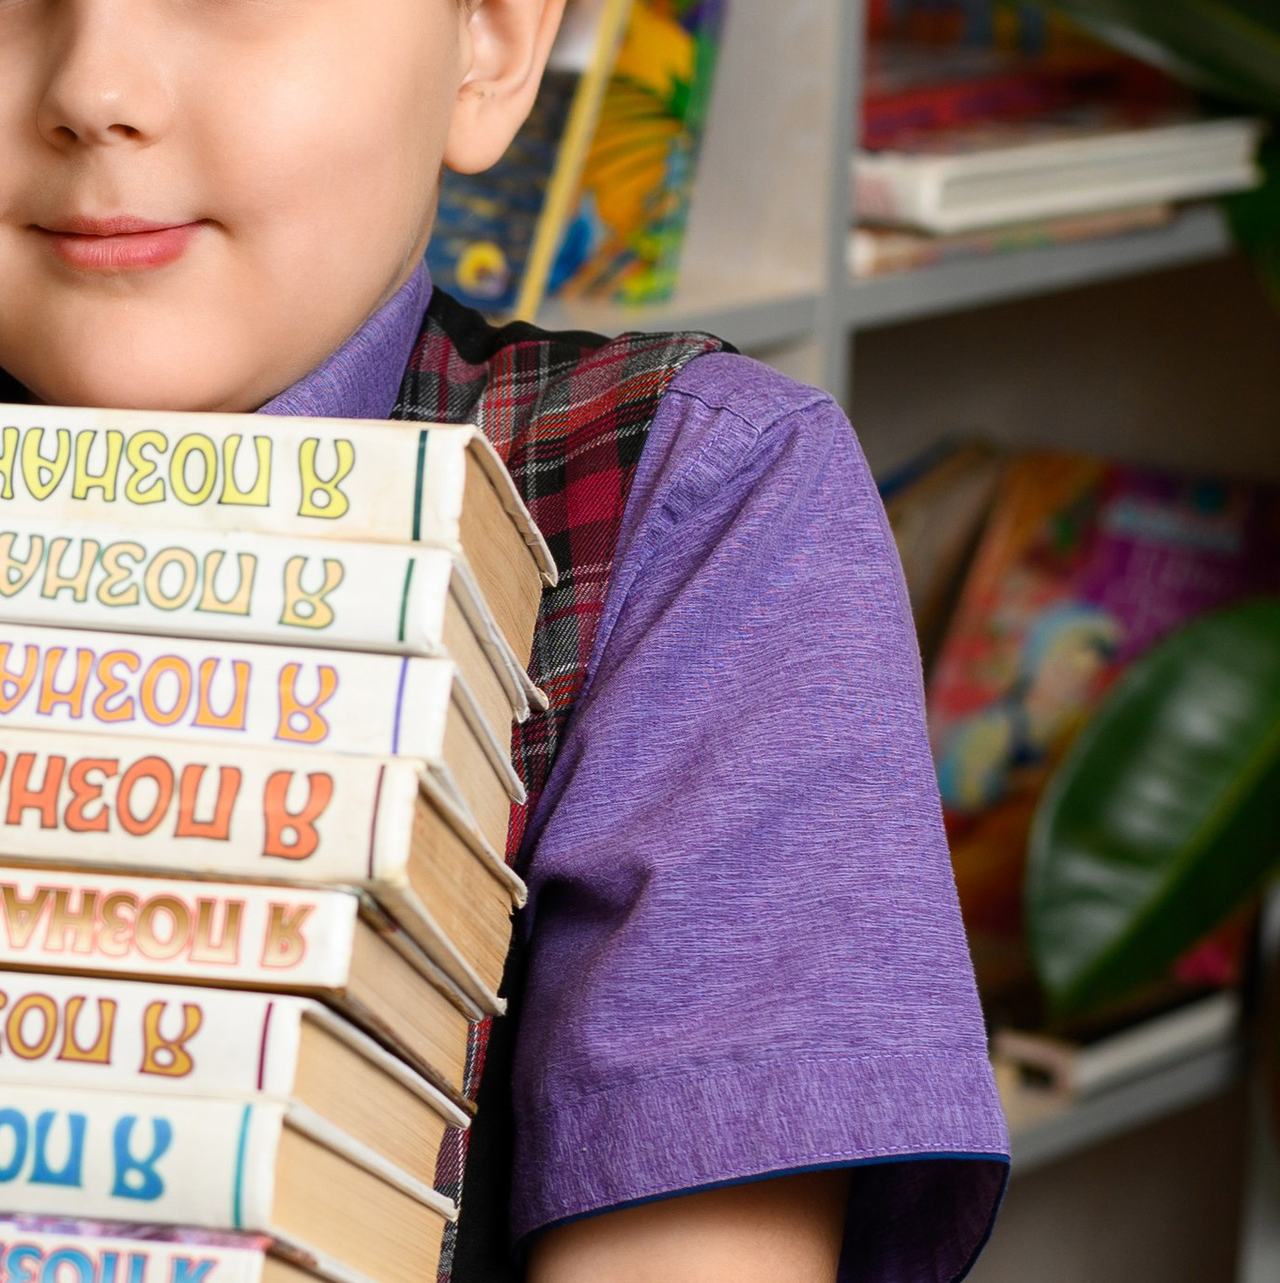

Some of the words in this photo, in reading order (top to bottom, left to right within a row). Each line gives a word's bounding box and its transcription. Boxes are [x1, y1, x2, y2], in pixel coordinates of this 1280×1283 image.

[297, 437, 356, 520] Я
[277, 554, 345, 631] Я
[273, 661, 340, 746] Я
[262, 769, 334, 861] Я
[259, 899, 317, 970] Я
[138, 1000, 205, 1078] Я
[110, 1114, 175, 1202] Я
